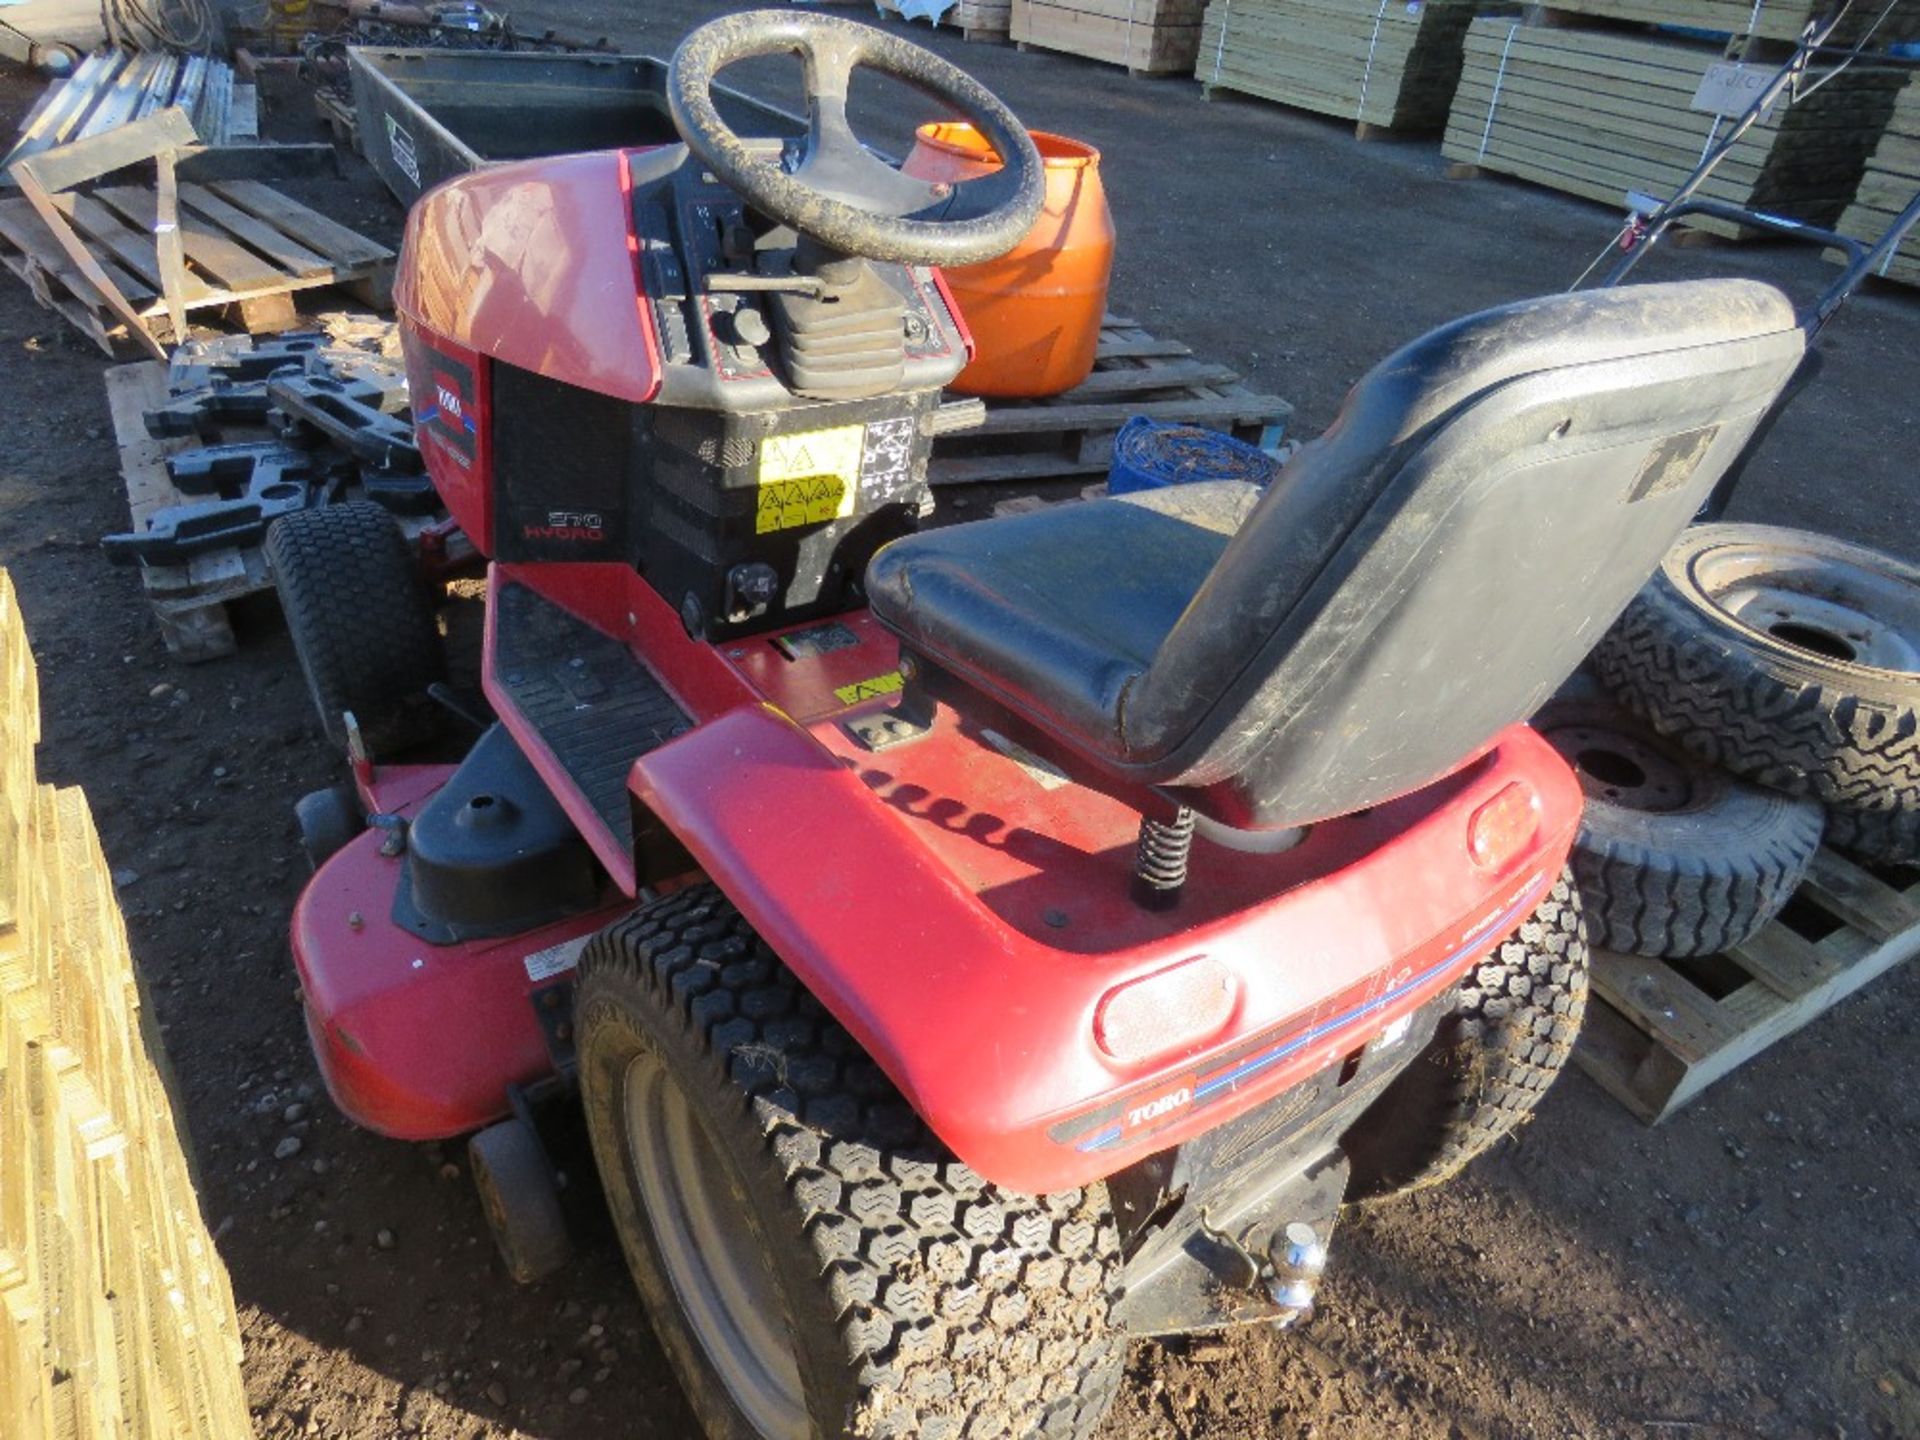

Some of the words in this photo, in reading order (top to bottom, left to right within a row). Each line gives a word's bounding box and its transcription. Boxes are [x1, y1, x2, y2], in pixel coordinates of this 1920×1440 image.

[548, 512, 602, 528] 270
[523, 527, 604, 541] HYDRO
[1128, 1087, 1190, 1127] TORO
